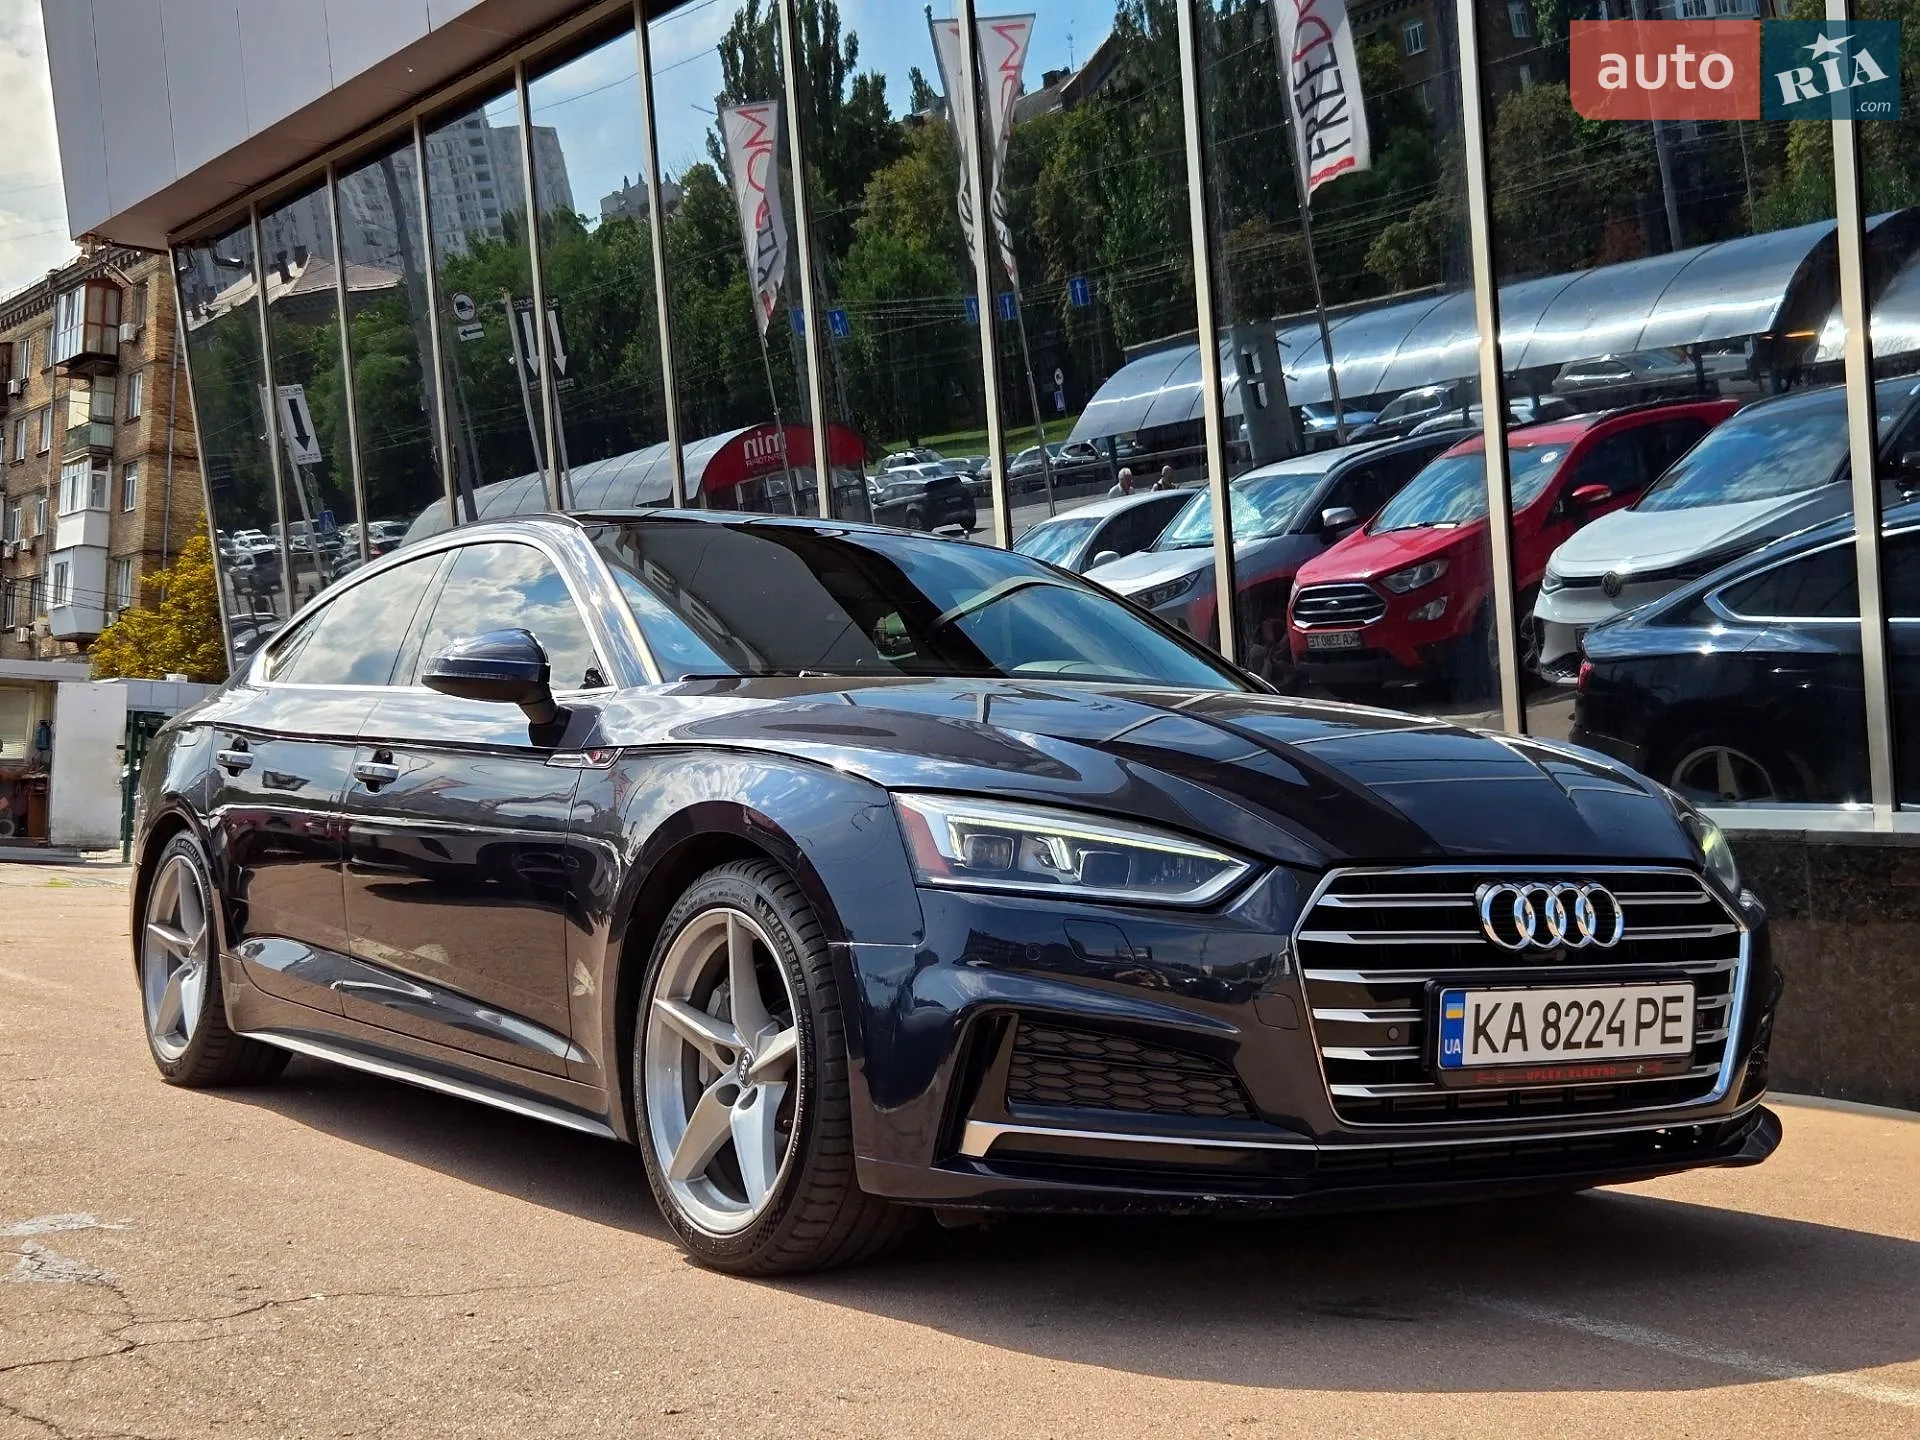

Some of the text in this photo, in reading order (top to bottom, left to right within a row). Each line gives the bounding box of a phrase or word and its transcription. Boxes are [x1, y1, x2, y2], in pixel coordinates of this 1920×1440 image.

[766, 912, 808, 997] MICHELIN
[1445, 1038, 1461, 1054] UA
[1472, 995, 1684, 1054] KA 8224 PE
